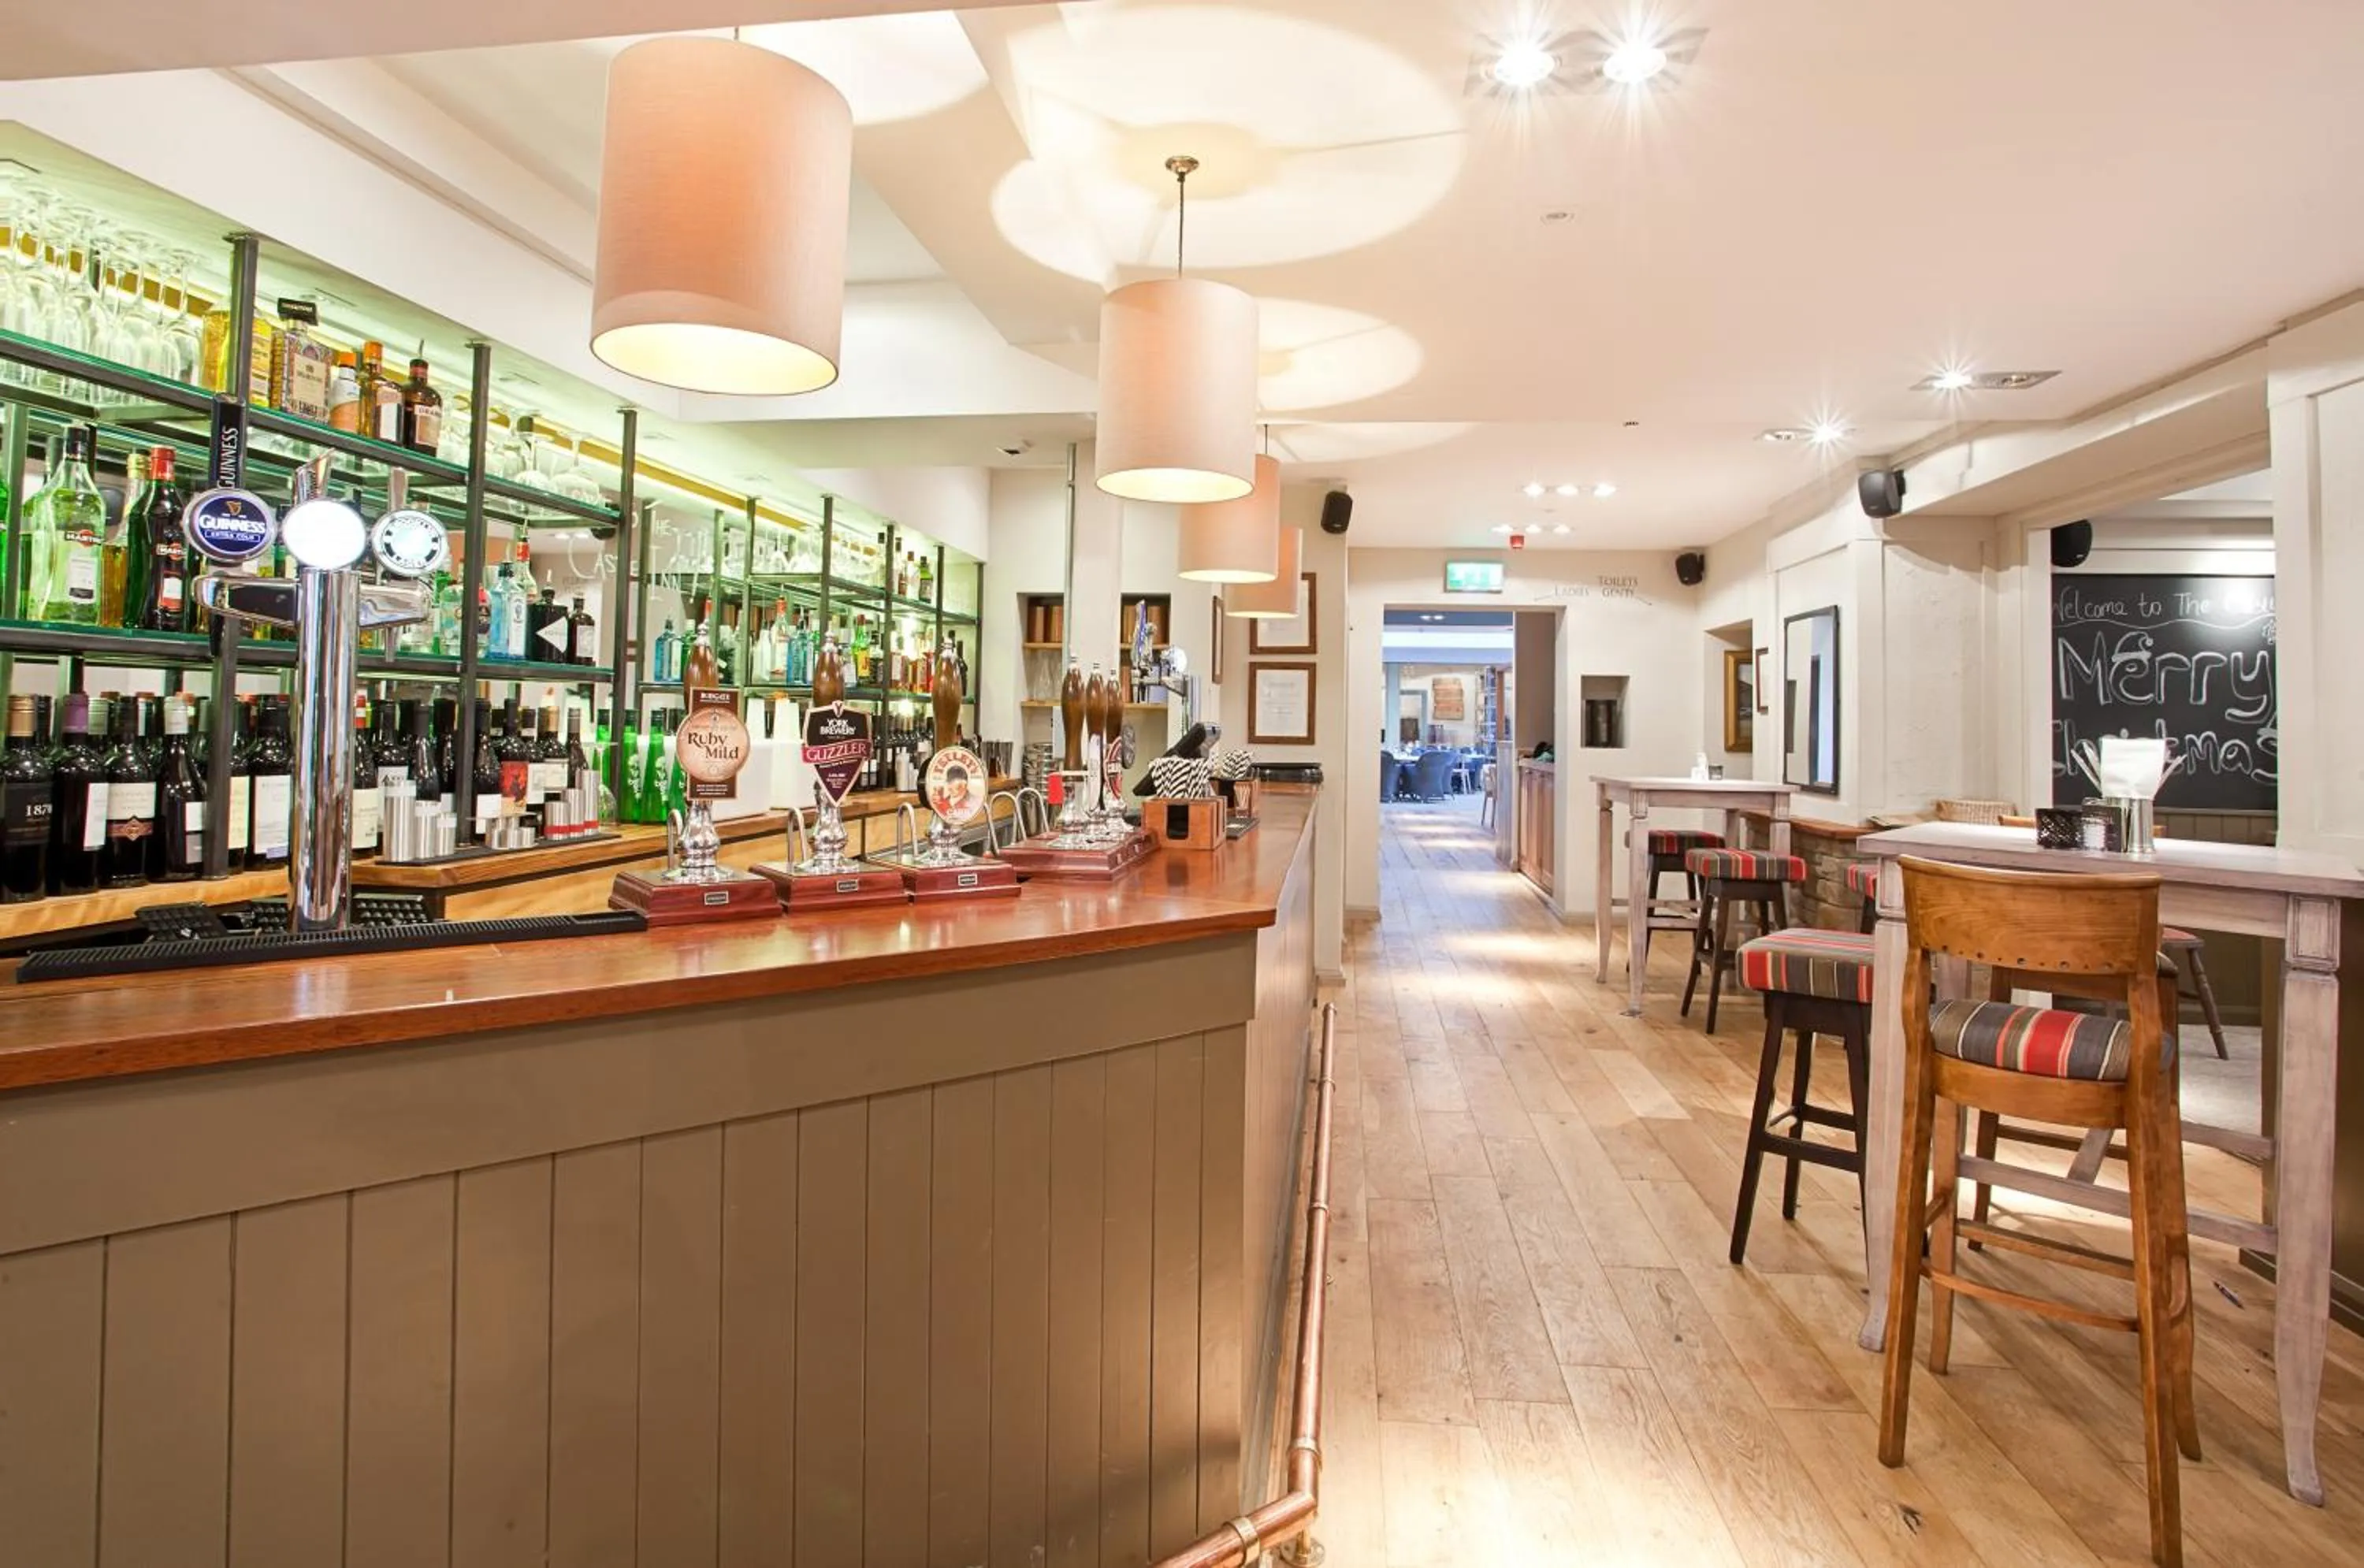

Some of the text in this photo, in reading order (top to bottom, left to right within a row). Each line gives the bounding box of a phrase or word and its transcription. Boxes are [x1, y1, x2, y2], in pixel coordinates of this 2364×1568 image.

[217, 425, 239, 489] GUINNESS
[199, 515, 266, 534] GUINNESS
[2139, 593, 2161, 618] to
[2173, 592, 2210, 616] The
[2057, 630, 2274, 723] Merry
[820, 726, 856, 735] BREWERY
[827, 718, 849, 726] YORK
[688, 732, 727, 748] Ruby
[704, 746, 738, 759] Mild
[806, 742, 867, 760] GUZZLER
